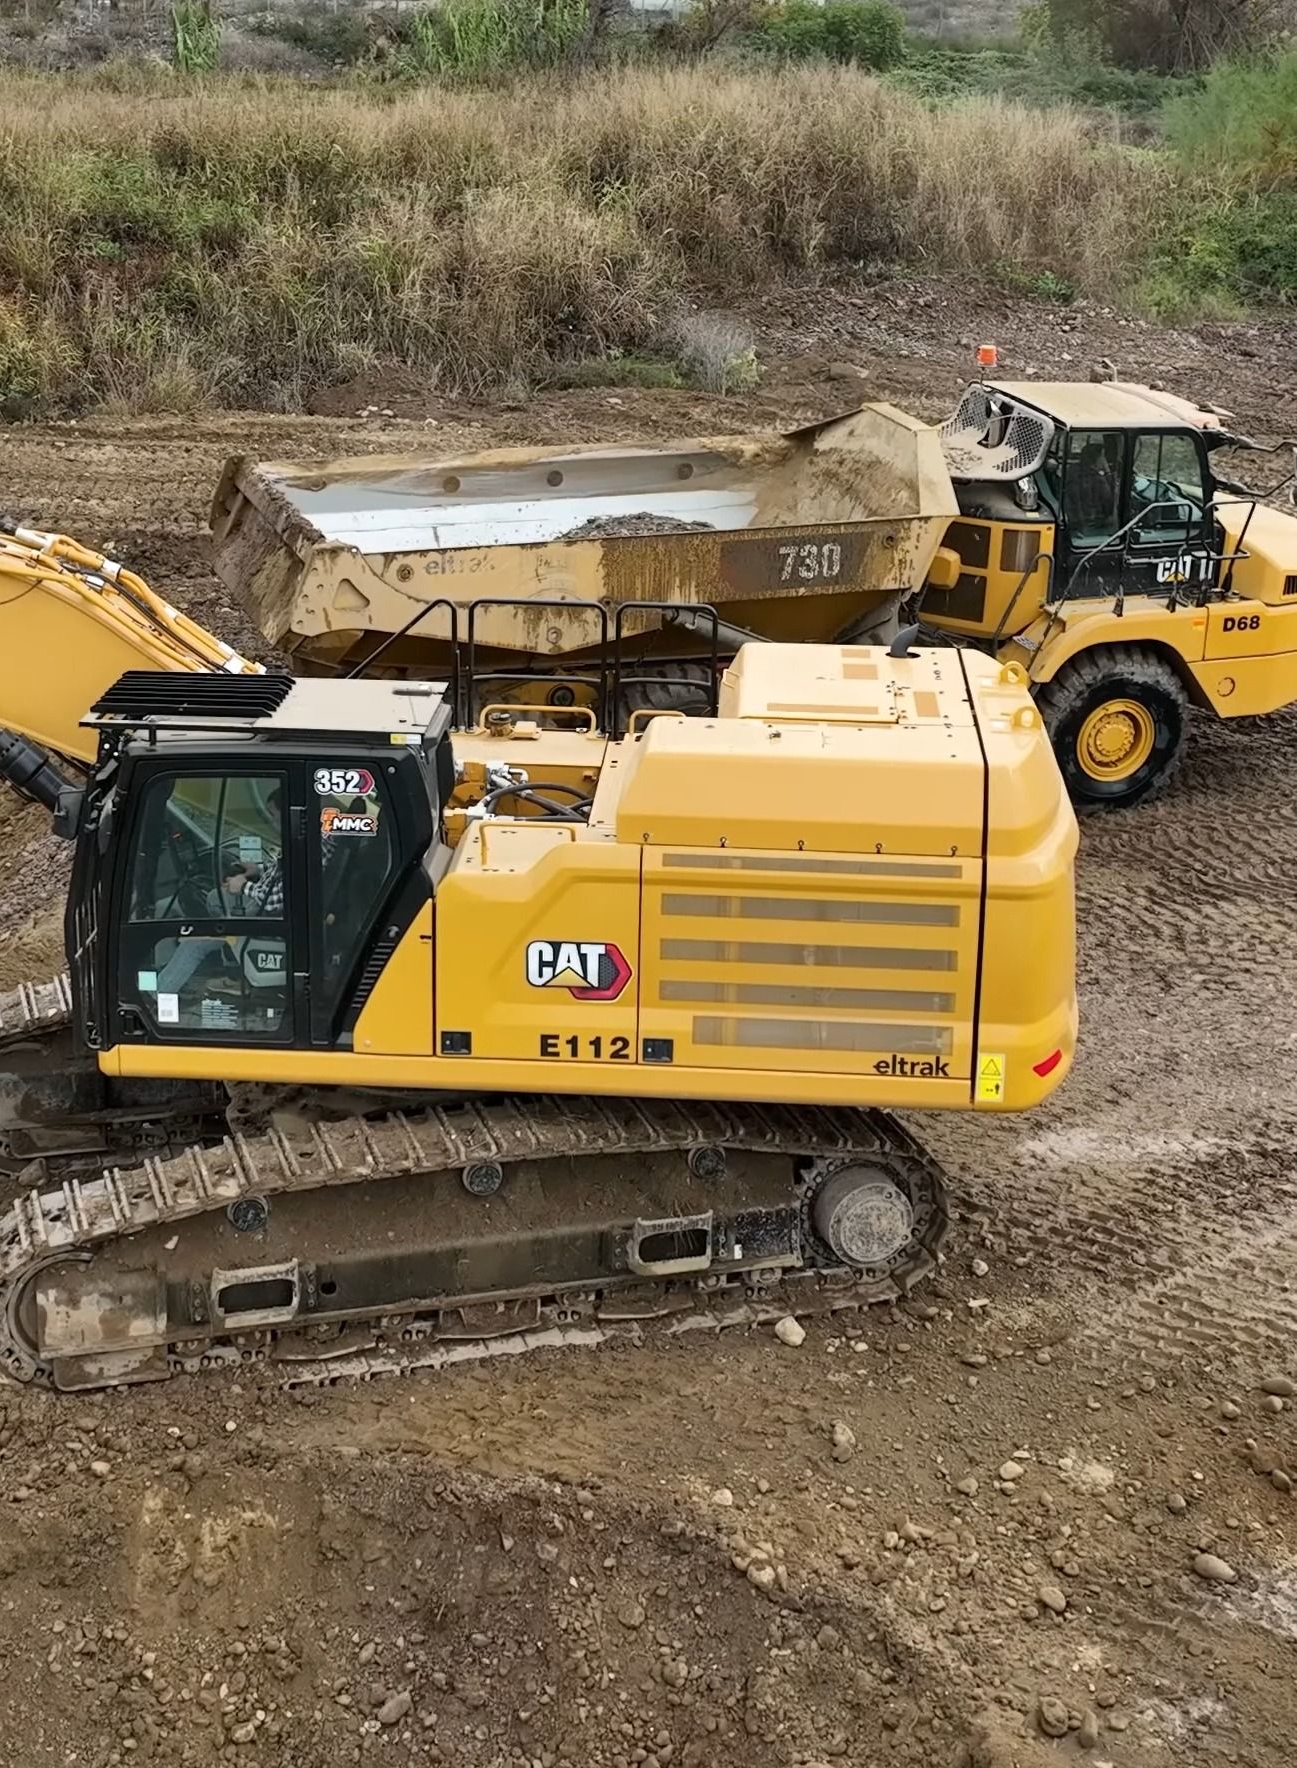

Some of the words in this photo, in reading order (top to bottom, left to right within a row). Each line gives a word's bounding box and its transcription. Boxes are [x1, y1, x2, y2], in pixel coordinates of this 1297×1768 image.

[779, 543, 841, 580] 730
[1223, 615, 1260, 632] D68
[316, 770, 360, 793] 352
[332, 817, 372, 831] MMC
[257, 952, 283, 970] CAT
[527, 940, 606, 988] CAT
[540, 1034, 630, 1060] E112
[872, 1054, 950, 1077] eltrak
